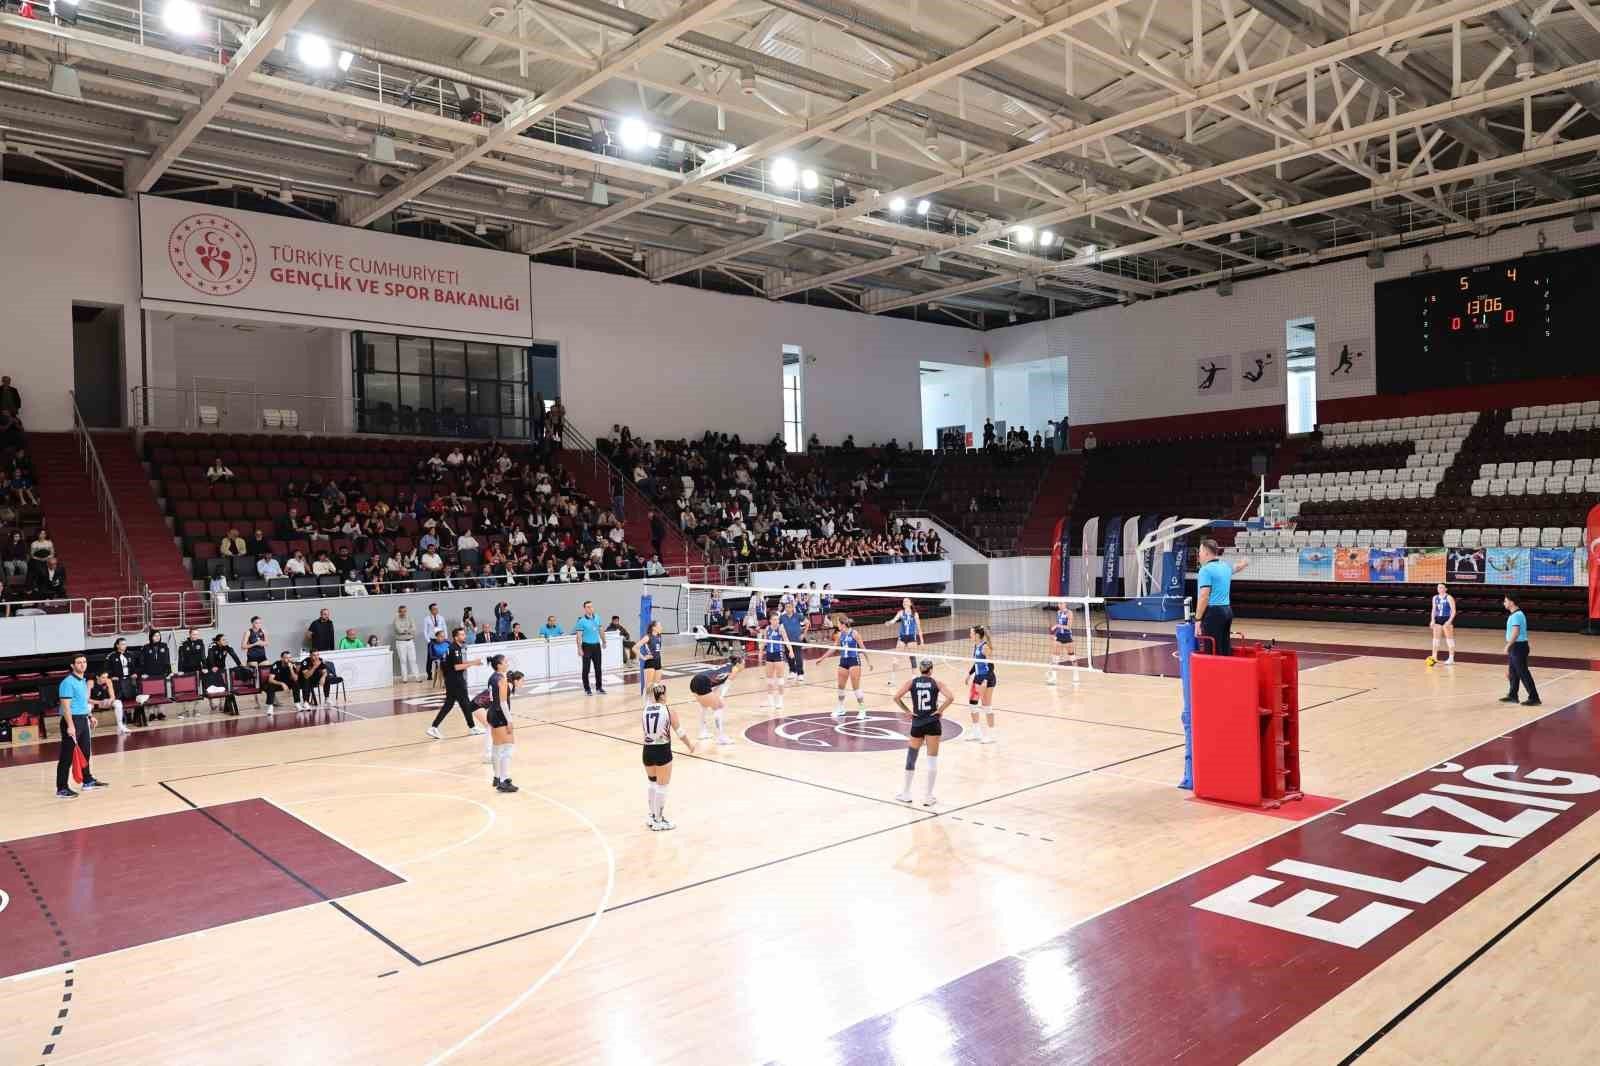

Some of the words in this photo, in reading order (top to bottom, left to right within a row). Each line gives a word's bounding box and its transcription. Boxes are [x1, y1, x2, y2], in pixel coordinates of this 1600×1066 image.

[270, 245, 344, 270] TÜRKİYE
[349, 257, 460, 286] CUMHURİYETİ
[1507, 268, 1517, 281] 4
[270, 267, 352, 292] GENÇLİK
[356, 278, 379, 295] VE
[384, 282, 430, 302] SPOR
[434, 289, 520, 312] BAKANLIĞI
[1460, 276, 1469, 290] 5
[1452, 317, 1461, 330] 0
[1505, 309, 1514, 322] 0
[917, 690, 931, 711] 12
[646, 712, 660, 734] 17
[1191, 762, 1600, 949] ELAZIĞ
